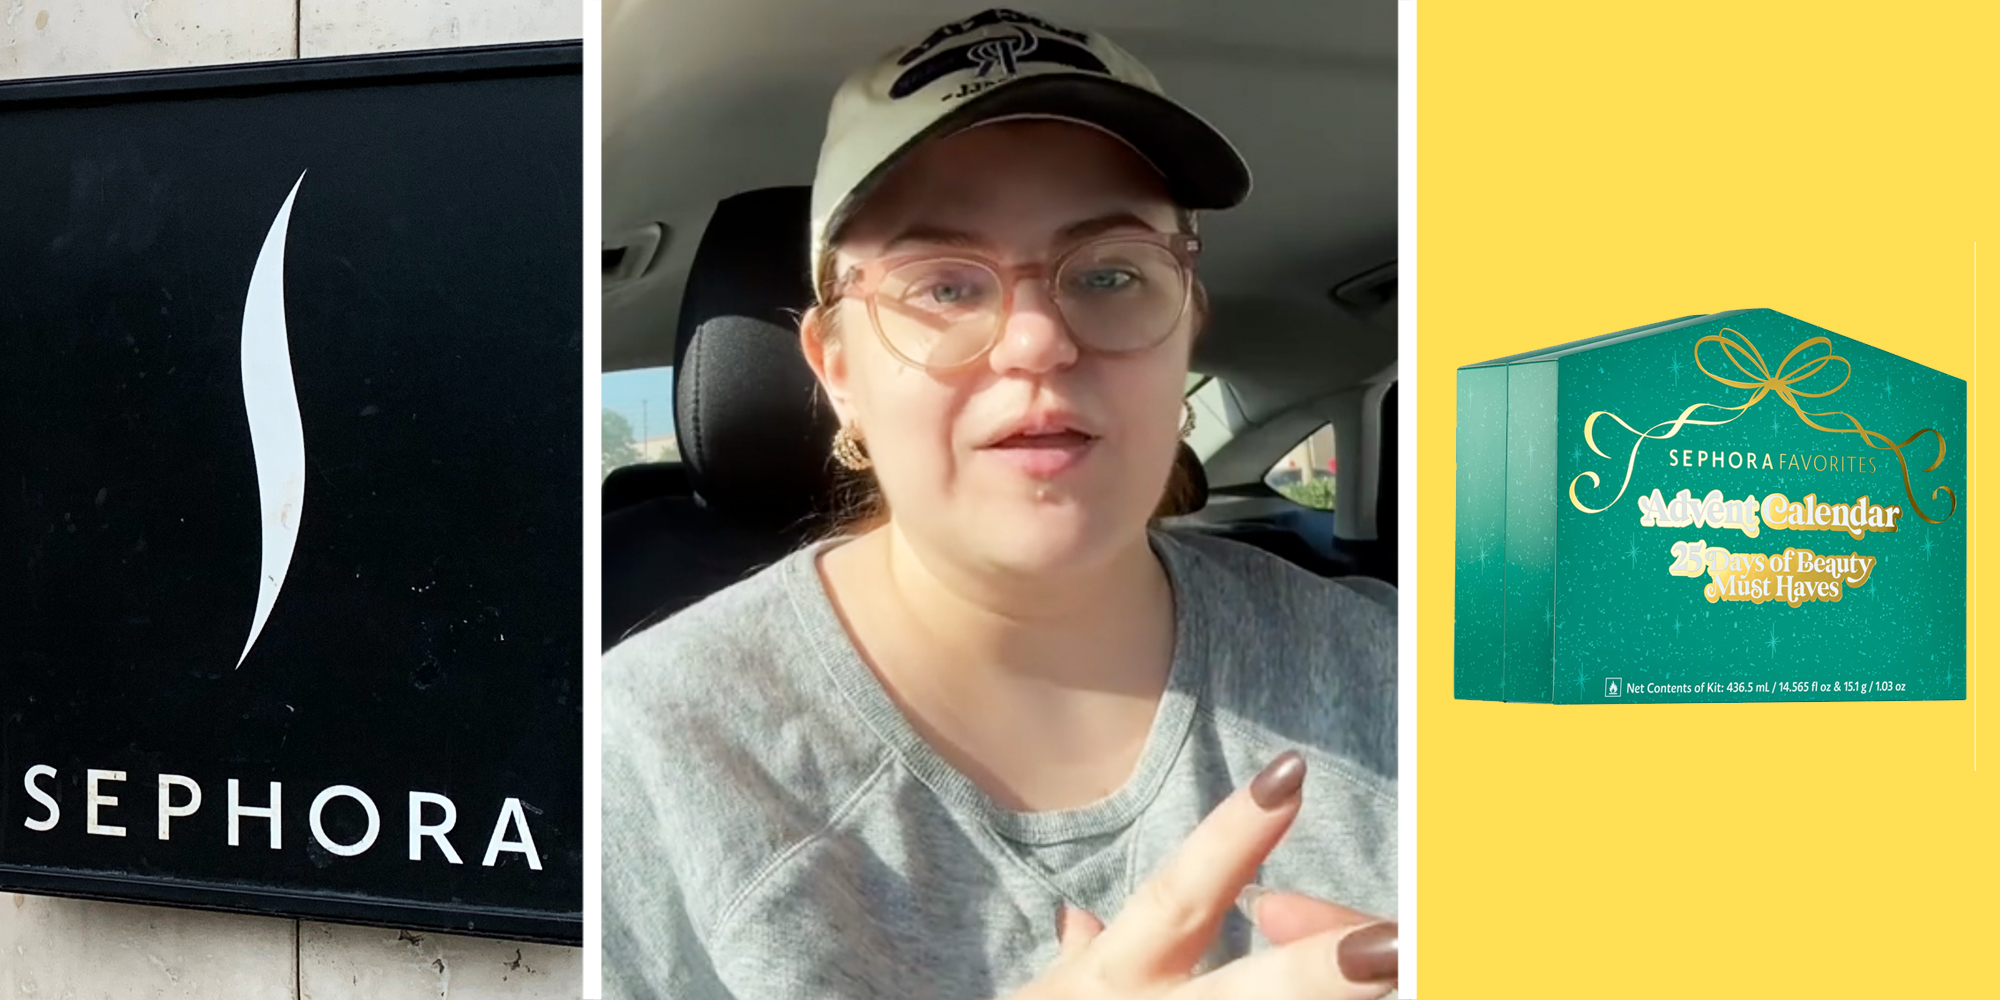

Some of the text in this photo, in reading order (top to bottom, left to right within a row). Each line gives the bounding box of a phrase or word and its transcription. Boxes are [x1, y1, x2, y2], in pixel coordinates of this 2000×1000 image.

[1669, 449, 1876, 473] SEPHORA FAVORITES
[1640, 489, 1900, 535] Advent Calendar
[1671, 544, 1873, 583] 25 Days of Beauty
[1706, 574, 1839, 602] Must Haves
[1626, 682, 1645, 694] Net
[1647, 682, 1692, 694] Contents
[1694, 682, 1705, 693] of
[1707, 682, 1724, 693] Kit:
[1726, 682, 1753, 693] 436.5
[1755, 682, 1770, 693] mL
[1779, 681, 1809, 692] 14.565
[1811, 681, 1818, 692] fl
[1820, 682, 1831, 692] oz
[1833, 681, 1841, 692] &
[1844, 681, 1859, 692] 15.1
[1861, 683, 1867, 695] g
[1876, 681, 1893, 692] 1.03
[1895, 683, 1906, 692] oz
[23, 763, 544, 871] SEPHORA
